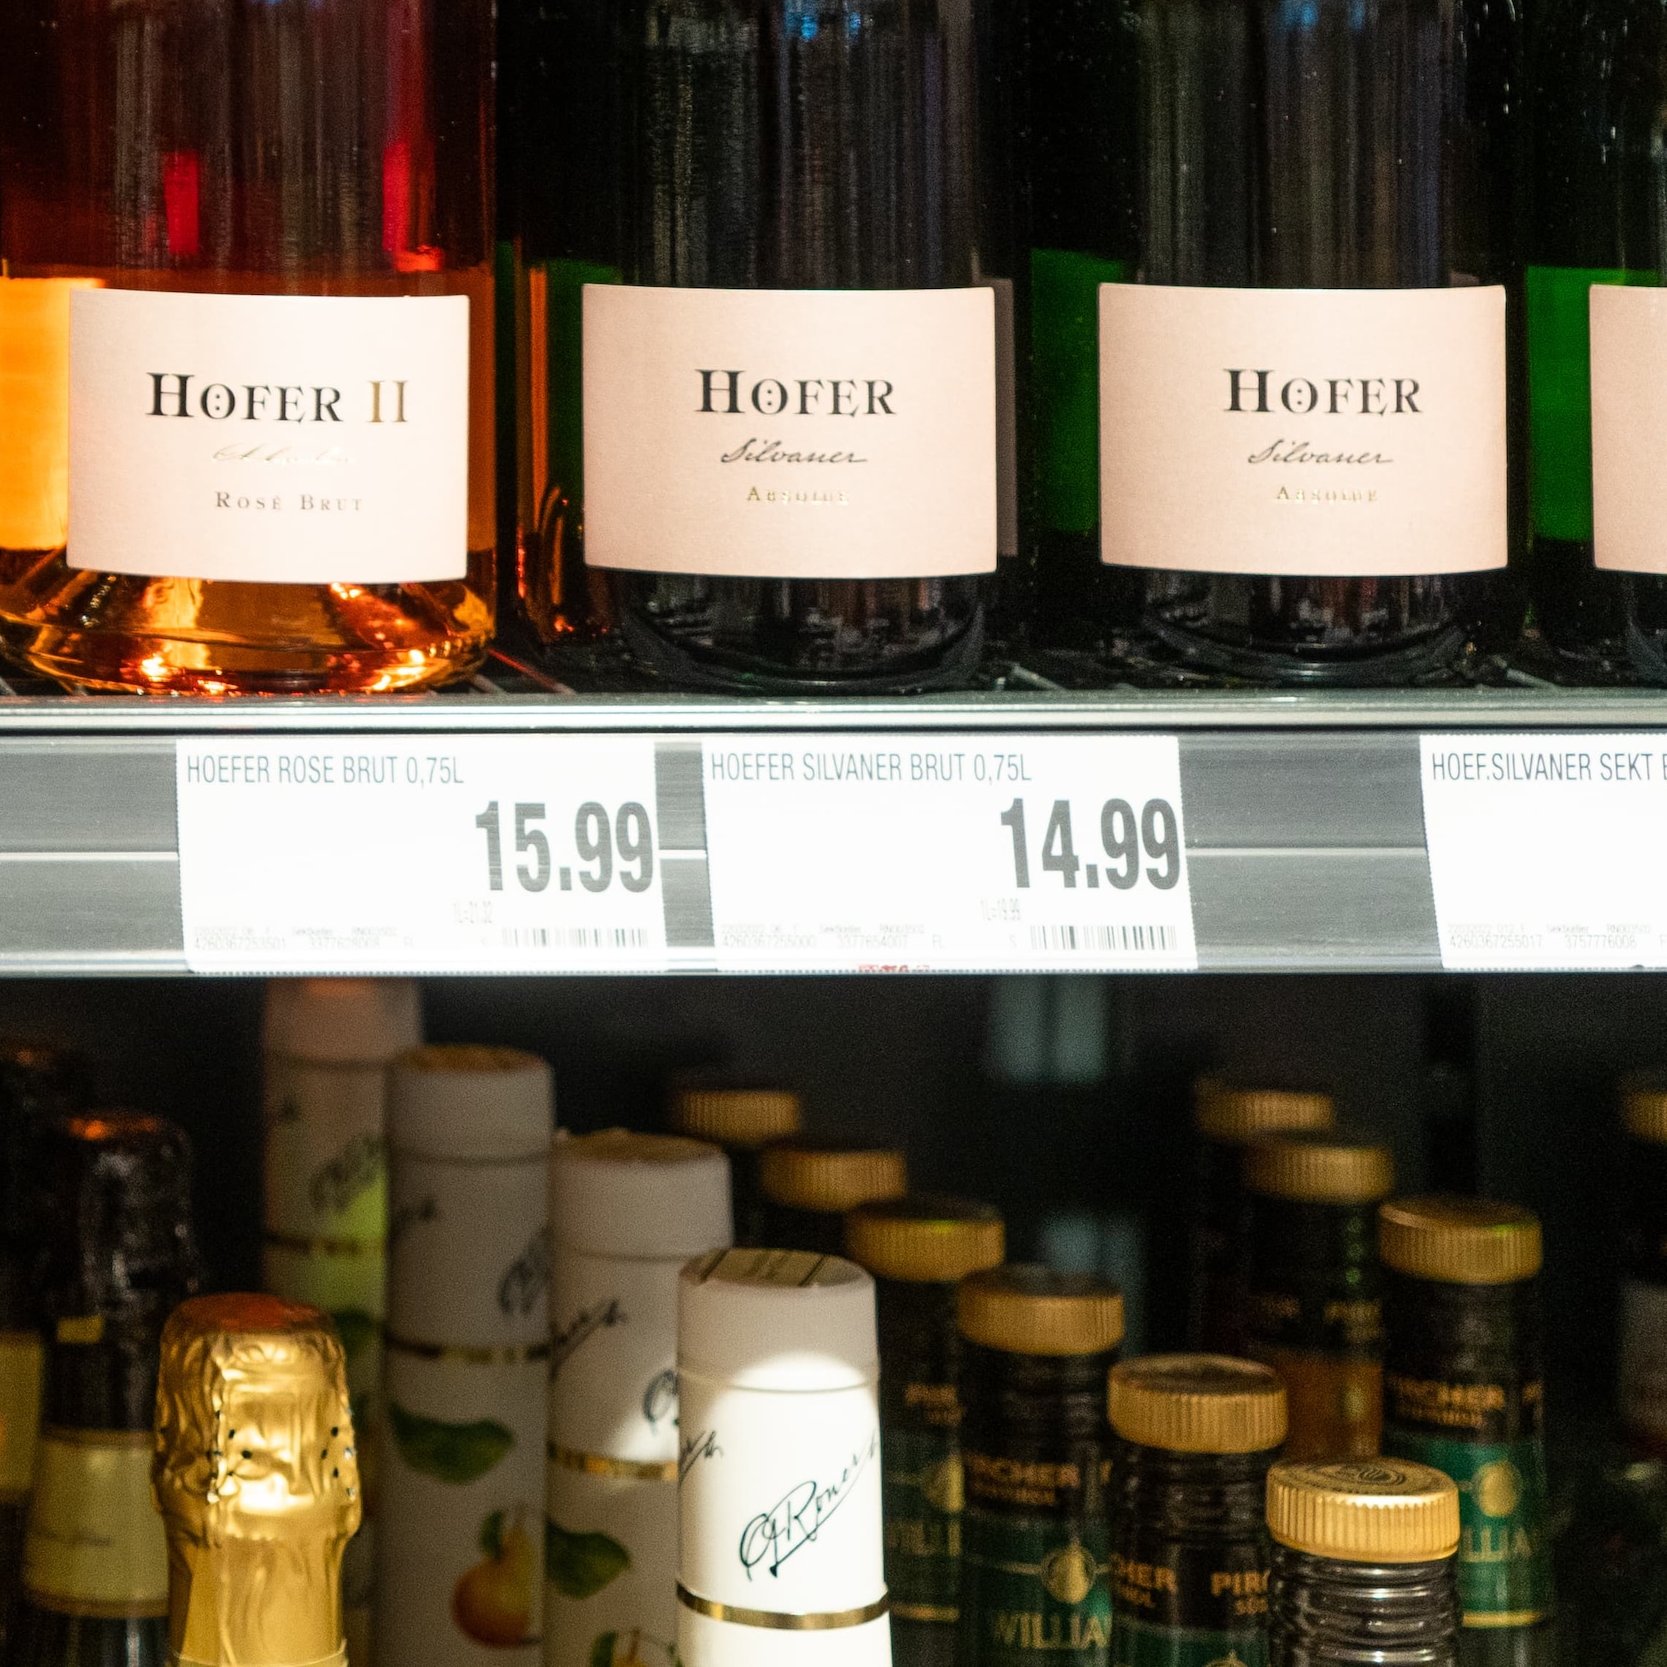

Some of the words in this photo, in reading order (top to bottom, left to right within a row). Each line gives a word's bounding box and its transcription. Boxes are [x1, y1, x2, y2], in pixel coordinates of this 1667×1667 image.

[366, 380, 410, 424] II
[187, 755, 270, 784] HOEFER
[278, 756, 335, 784] ROSE
[342, 756, 399, 784] BRUT
[405, 756, 464, 789] 0,75L
[711, 753, 795, 781] HOEFER
[802, 753, 903, 781] SILVANER
[910, 754, 965, 781] BRUT
[973, 755, 1032, 785] 0,75L
[1431, 752, 1592, 781] HOEF.SILVANER
[1599, 752, 1653, 781] SEKT
[475, 800, 654, 893] 15.99
[1000, 798, 1180, 890] 14.99
